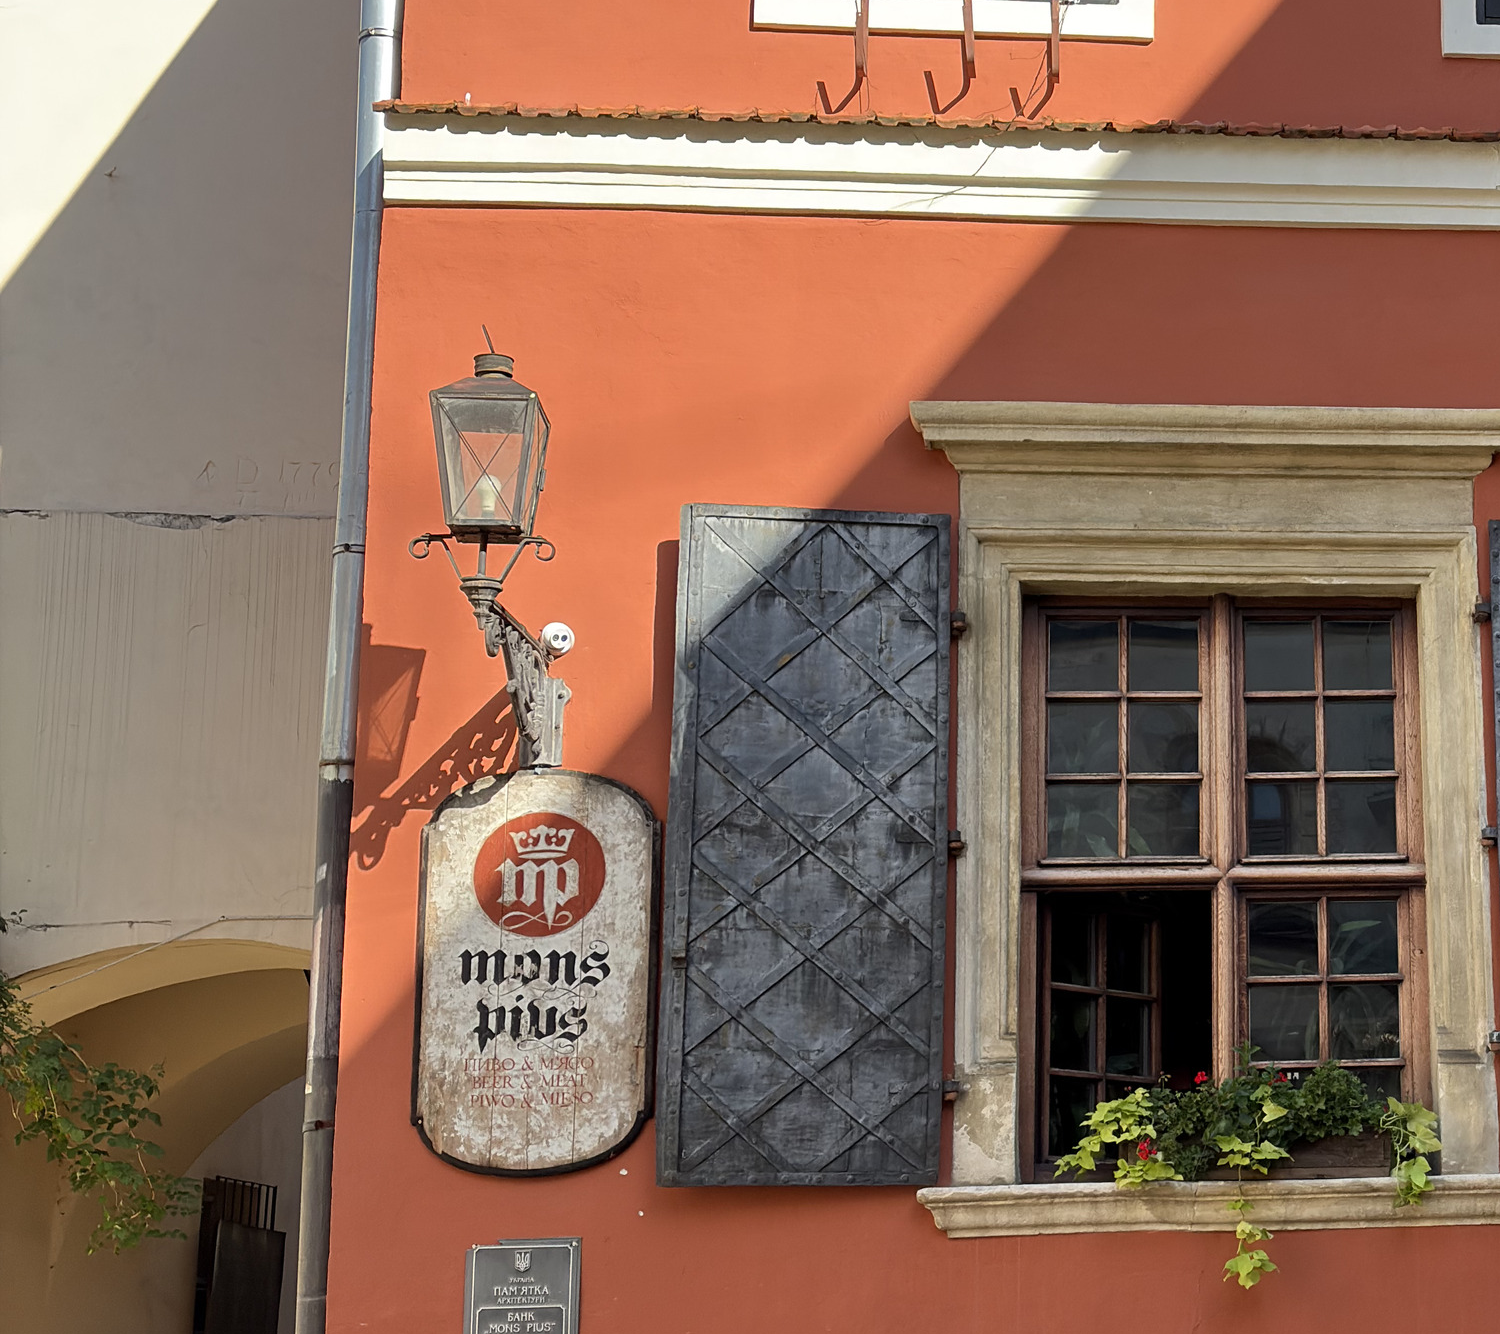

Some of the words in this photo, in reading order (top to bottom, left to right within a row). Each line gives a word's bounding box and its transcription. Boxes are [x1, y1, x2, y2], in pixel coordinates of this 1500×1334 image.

[458, 939, 611, 987] mons
[464, 1057, 515, 1072] ПИВО
[521, 1056, 534, 1071] &
[472, 1075, 515, 1089] BEER
[520, 1073, 533, 1090] &
[540, 1073, 588, 1088] MEAT
[470, 1093, 515, 1108] PIWO
[520, 1091, 533, 1108] &
[507, 1311, 535, 1322] БАНК
